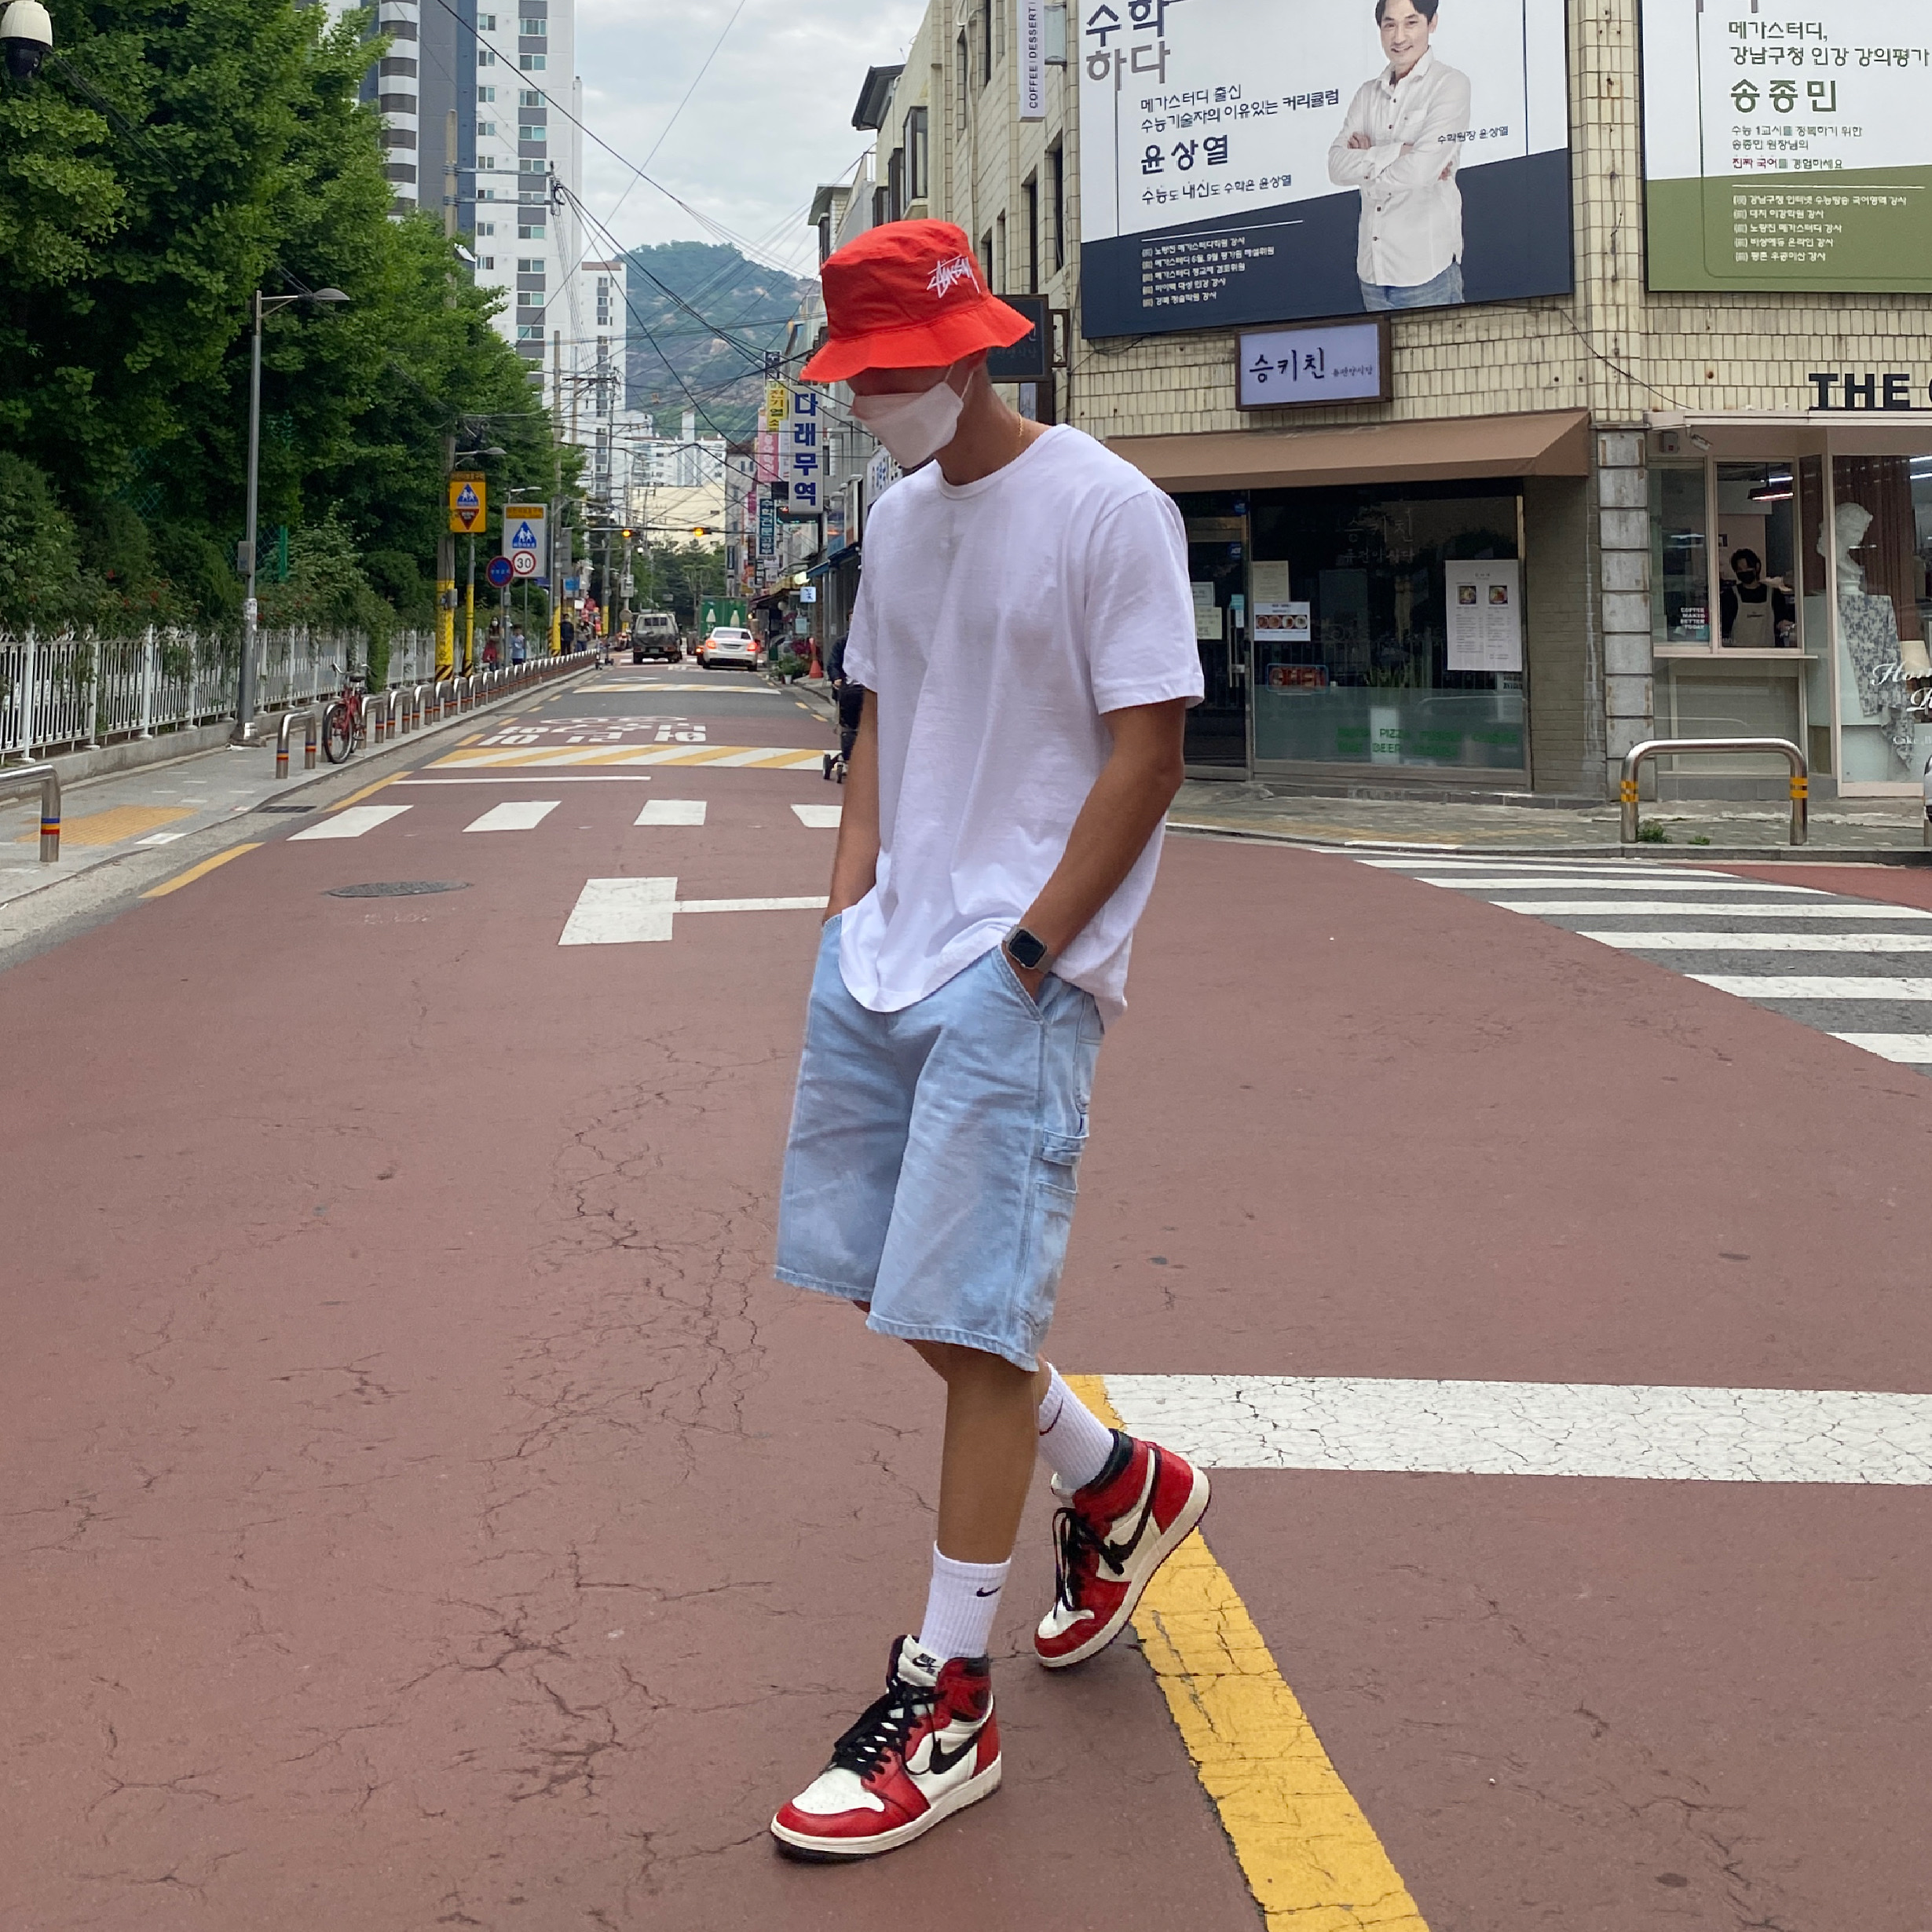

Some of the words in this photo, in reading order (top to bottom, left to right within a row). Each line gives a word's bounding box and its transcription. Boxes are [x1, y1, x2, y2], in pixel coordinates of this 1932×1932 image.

[1029, 7, 1038, 58] DESSERT
[1086, 0, 1170, 47] 수학
[1729, 21, 1828, 42] 메가스터디,
[1086, 41, 1170, 91] 하다
[1729, 46, 1803, 66] 강남구청
[1811, 47, 1849, 67] 인강
[1854, 47, 1930, 68] 강의평가
[1029, 65, 1038, 108] COFFEE
[1140, 89, 1208, 113] 메가스터디
[1214, 84, 1241, 103] 출신
[1730, 79, 1836, 114] 송종민
[1140, 108, 1220, 133] 수능기술자의
[1224, 100, 1279, 119] 이유있는
[1283, 89, 1339, 110] 커리큘럼
[1732, 126, 1751, 137] 수능
[1841, 126, 1863, 137] 위한
[1733, 139, 1764, 150] 송종민
[1767, 139, 1809, 151] 원장님의
[1140, 134, 1228, 175] 윤상열
[1142, 187, 1179, 205] 수능도
[1183, 181, 1220, 199] 내신도
[1224, 180, 1255, 194] 수학은
[1259, 174, 1292, 190] 윤상열
[1249, 347, 1325, 384] 승키친
[1808, 373, 1911, 410] THE
[793, 393, 818, 507] 다래무역
[517, 558, 532, 569] 30
